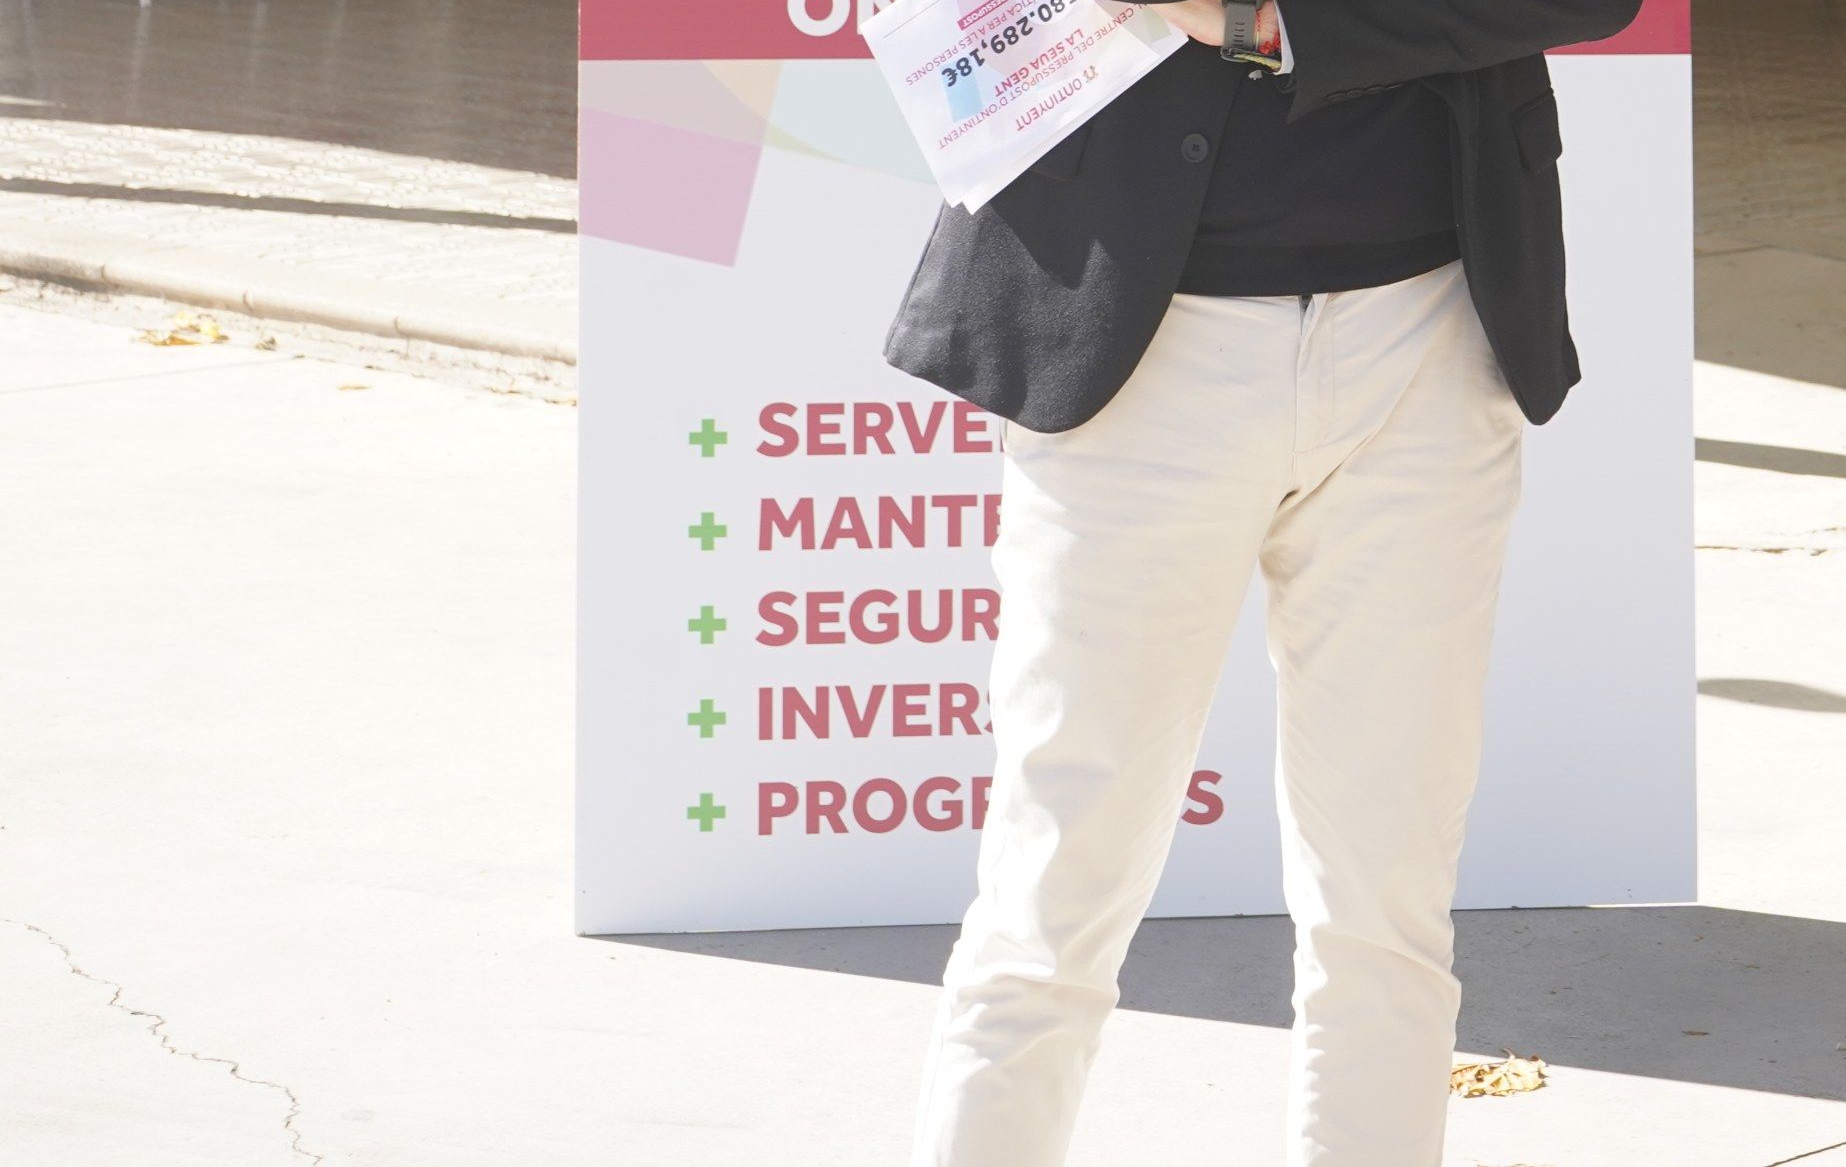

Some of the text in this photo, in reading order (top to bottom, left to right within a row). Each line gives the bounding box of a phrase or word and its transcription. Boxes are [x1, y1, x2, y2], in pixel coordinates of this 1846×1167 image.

[958, 32, 978, 49] LES
[987, 12, 1008, 31] PER
[1093, 6, 1136, 41] CENTRE
[904, 45, 959, 86] PERSONES
[991, 28, 1084, 97] LA SEUA GENT
[1073, 36, 1095, 56] DEL
[1006, 50, 1075, 102] PRESSUPOST
[935, 96, 1009, 150] D'ONTINYENT
[1012, 77, 1083, 132] ONTINYENT
[757, 682, 994, 741] INVER
